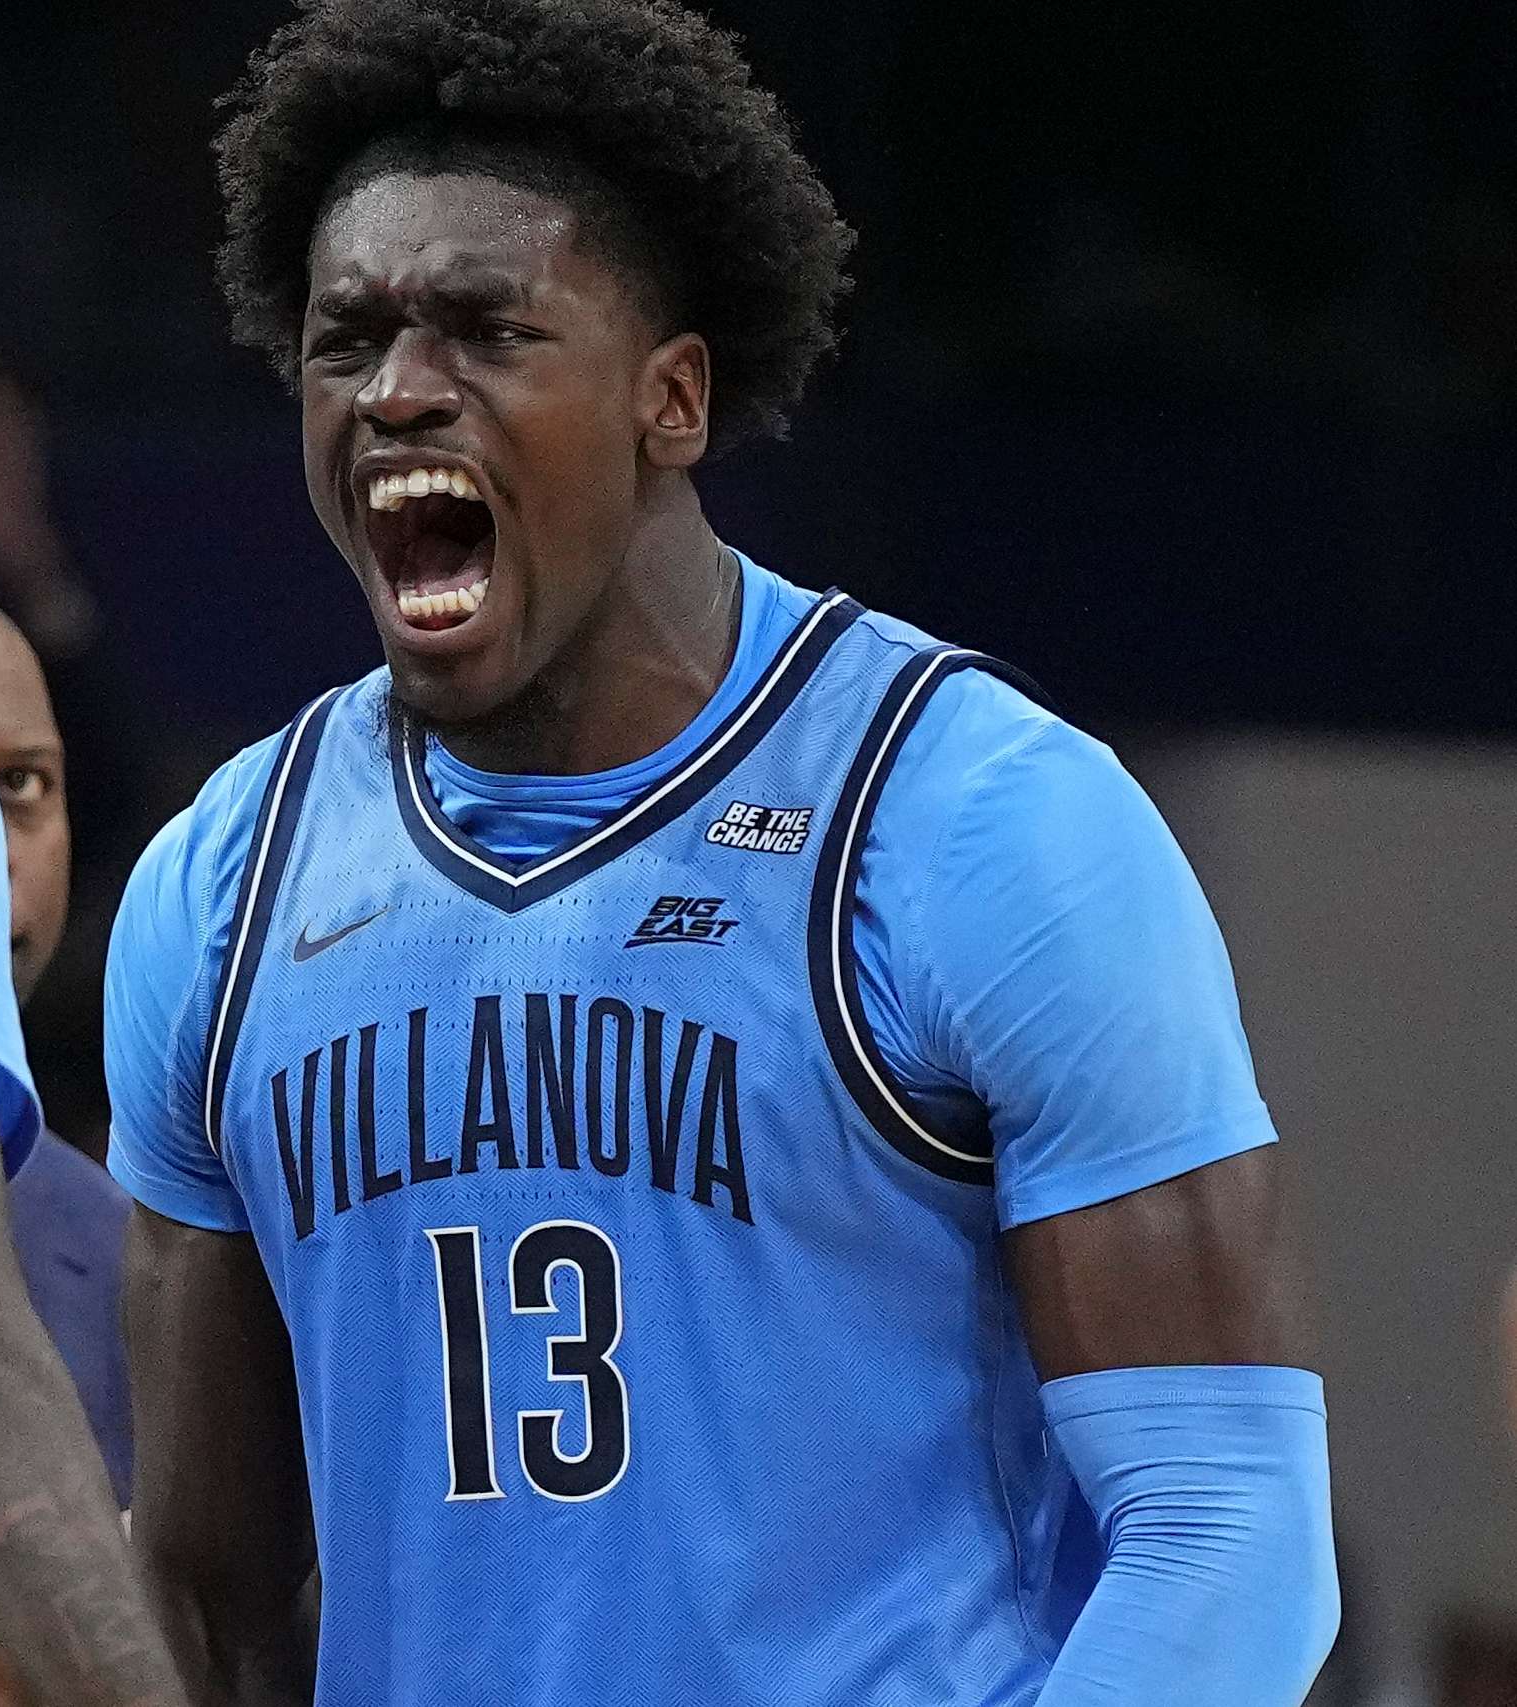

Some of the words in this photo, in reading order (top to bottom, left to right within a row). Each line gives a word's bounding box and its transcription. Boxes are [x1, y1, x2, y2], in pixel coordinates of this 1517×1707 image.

[724, 803, 764, 827] BE
[768, 810, 812, 831] THE
[706, 823, 807, 853] CHANGE
[648, 896, 726, 917] BIG
[633, 917, 740, 938] EAST
[271, 993, 756, 1241] VILLANOVA
[423, 1218, 630, 1502] 13
